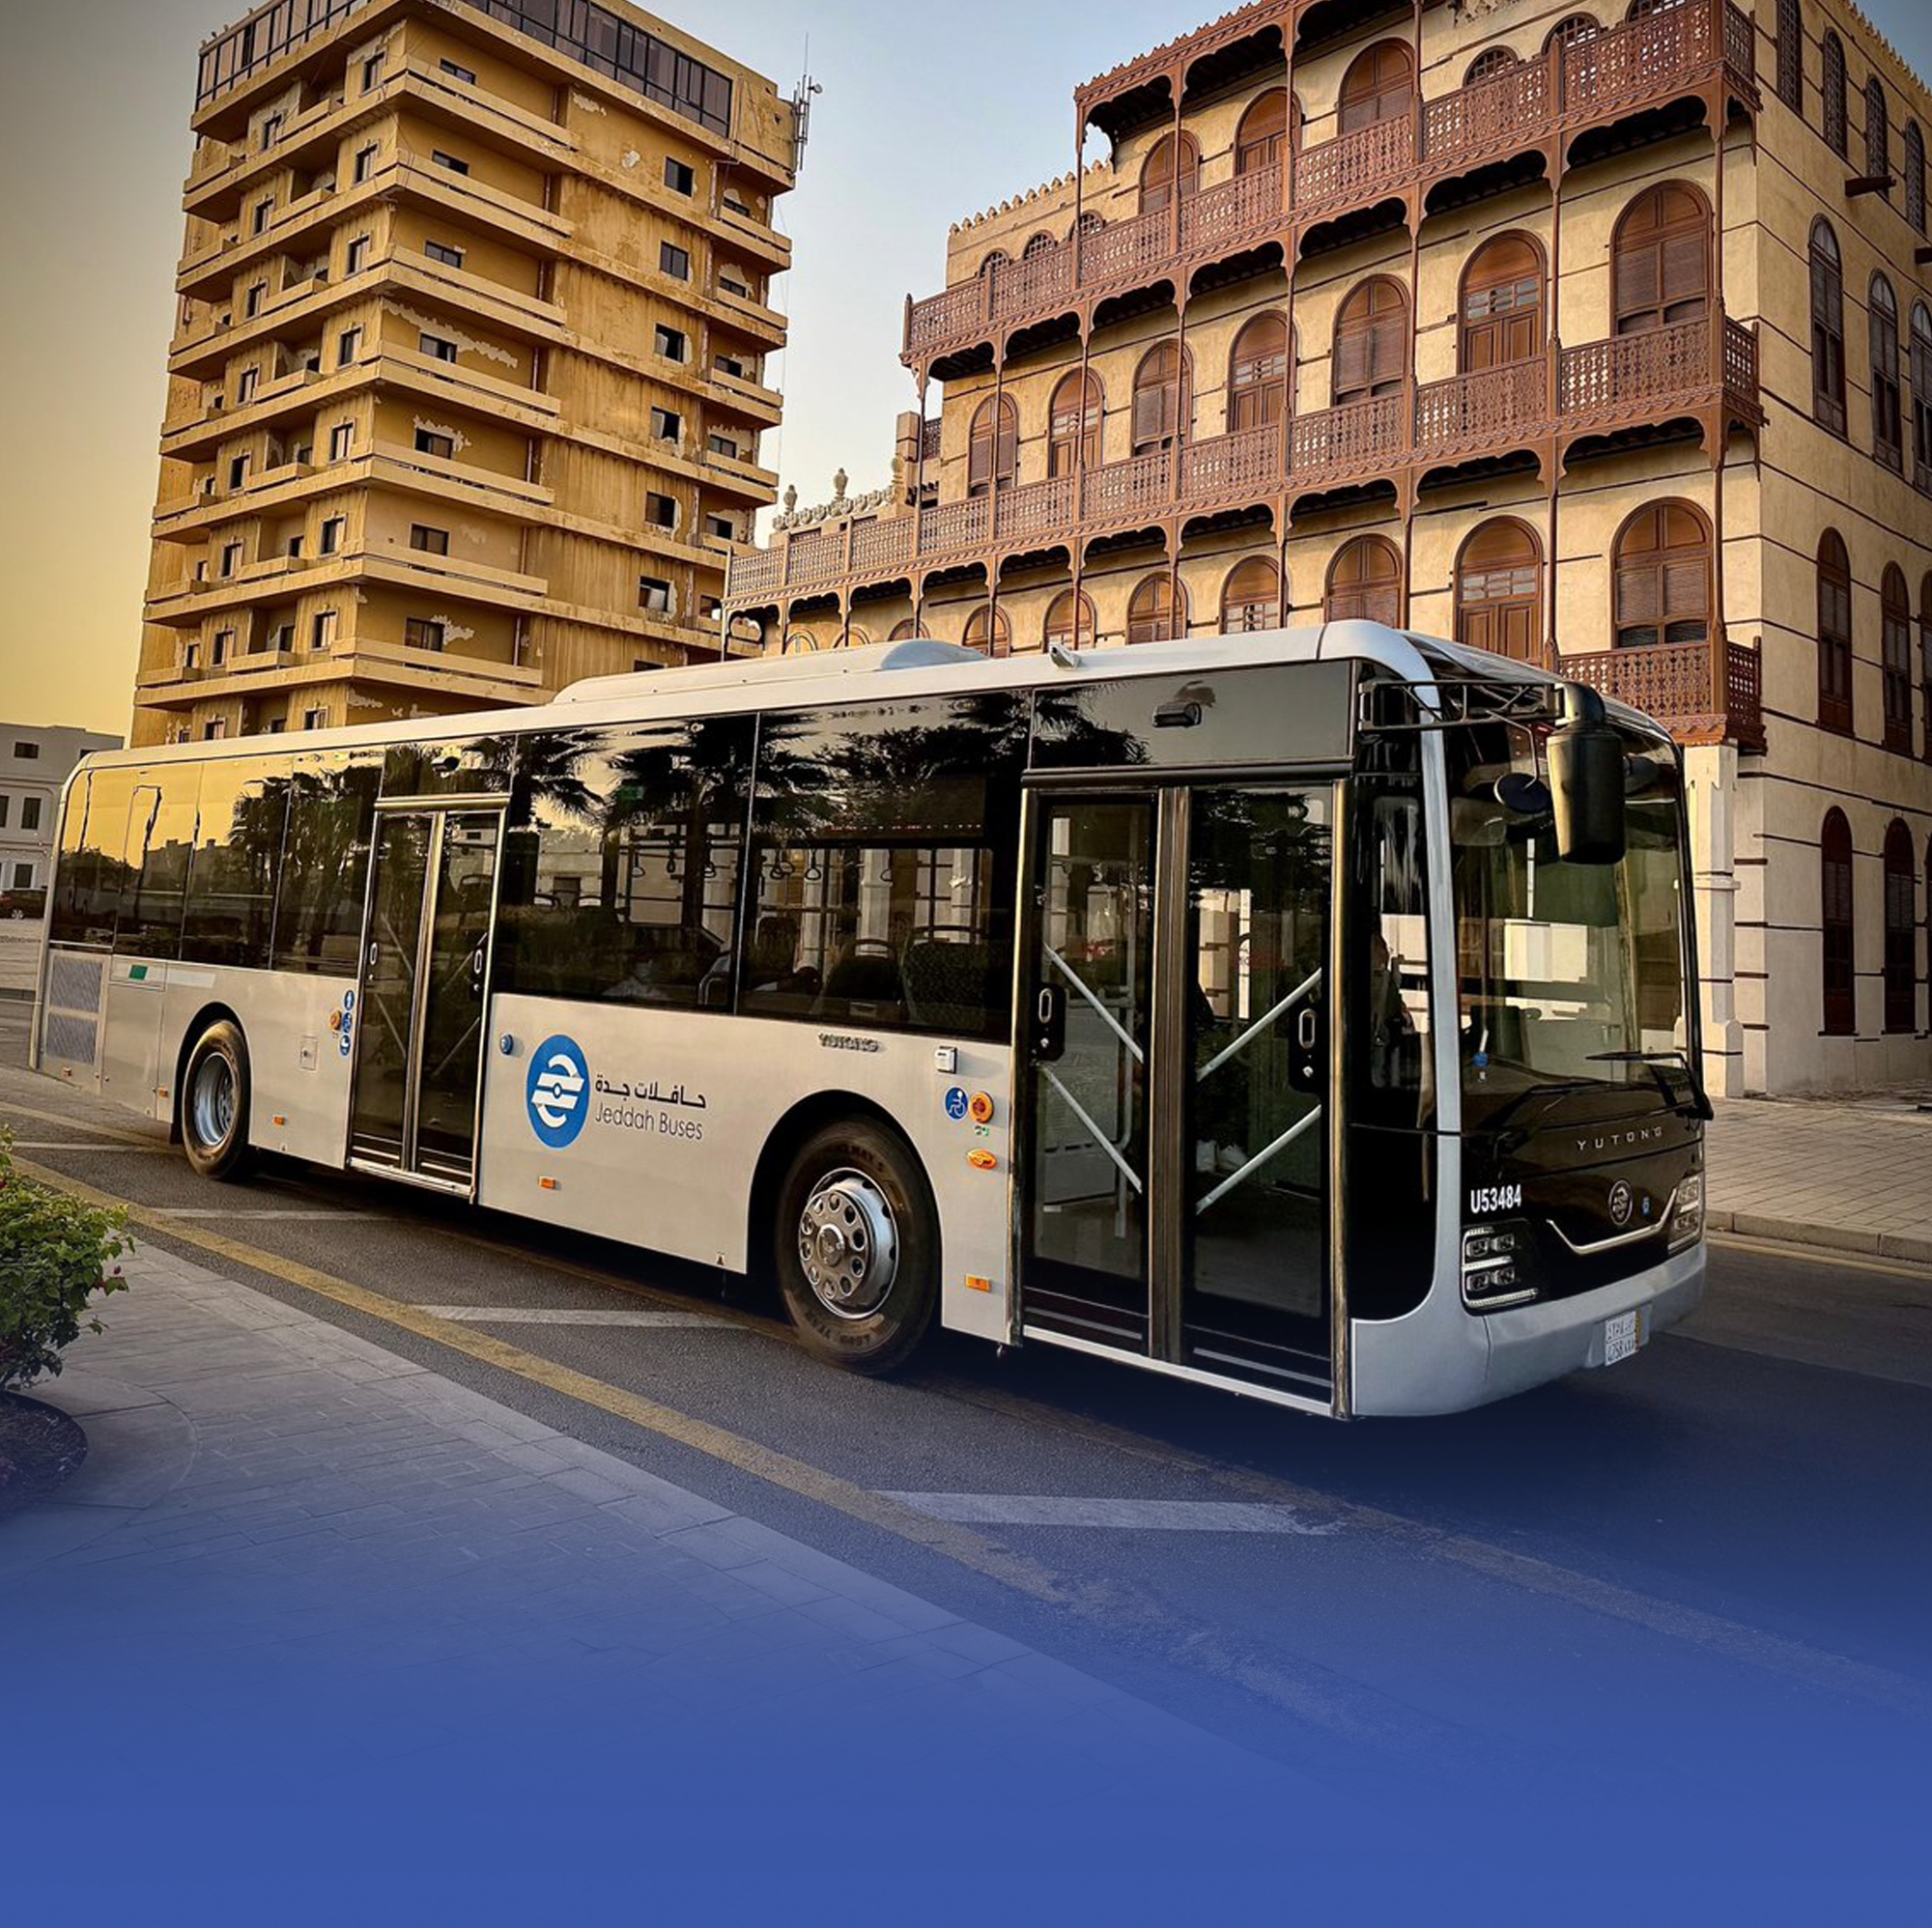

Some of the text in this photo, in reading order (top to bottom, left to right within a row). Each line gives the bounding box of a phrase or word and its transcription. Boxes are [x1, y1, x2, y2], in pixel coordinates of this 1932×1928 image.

[595, 1074, 706, 1109] حافلات جدة
[595, 1101, 702, 1140] Jeddah Buses
[1577, 1126, 1662, 1150] YUTONG
[1470, 1184, 1521, 1214] U53484
